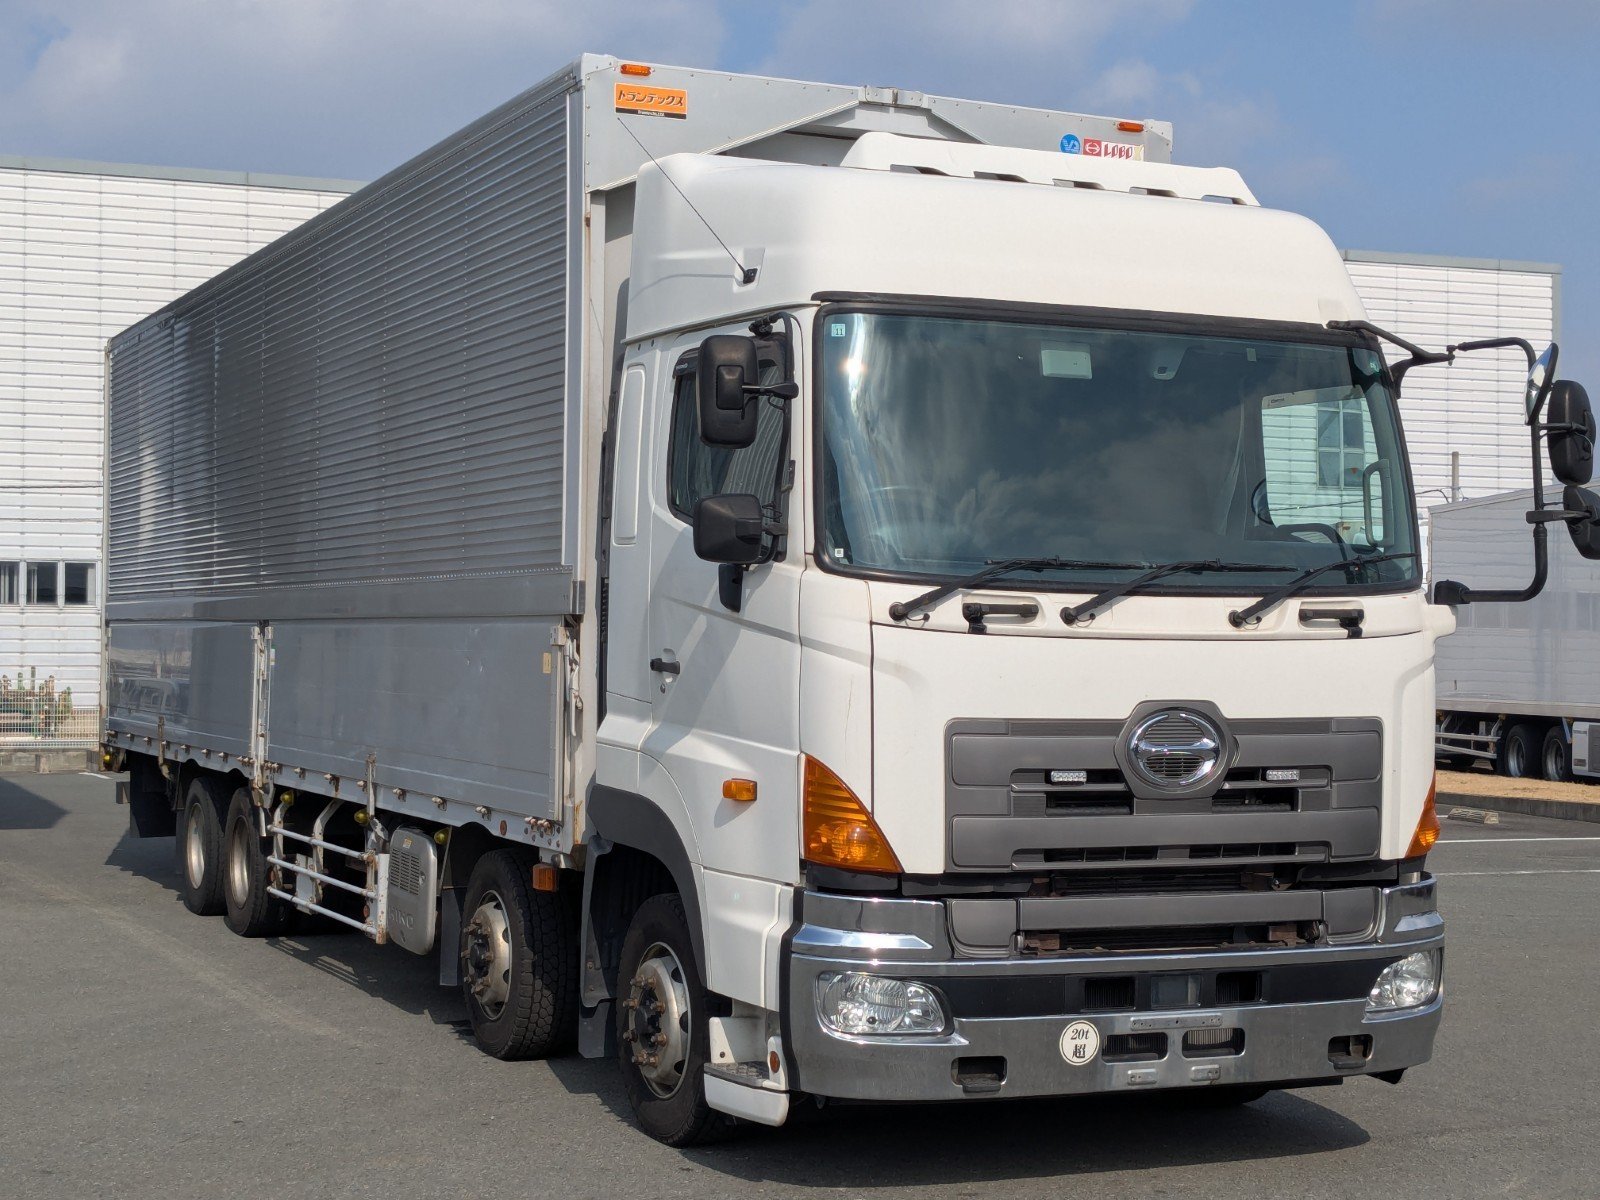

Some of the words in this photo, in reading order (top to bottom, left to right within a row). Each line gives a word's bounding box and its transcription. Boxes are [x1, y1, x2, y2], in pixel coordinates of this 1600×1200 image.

[618, 89, 684, 107] トランテックス
[1070, 1028, 1090, 1041] 20t
[1072, 1044, 1087, 1059] 超
